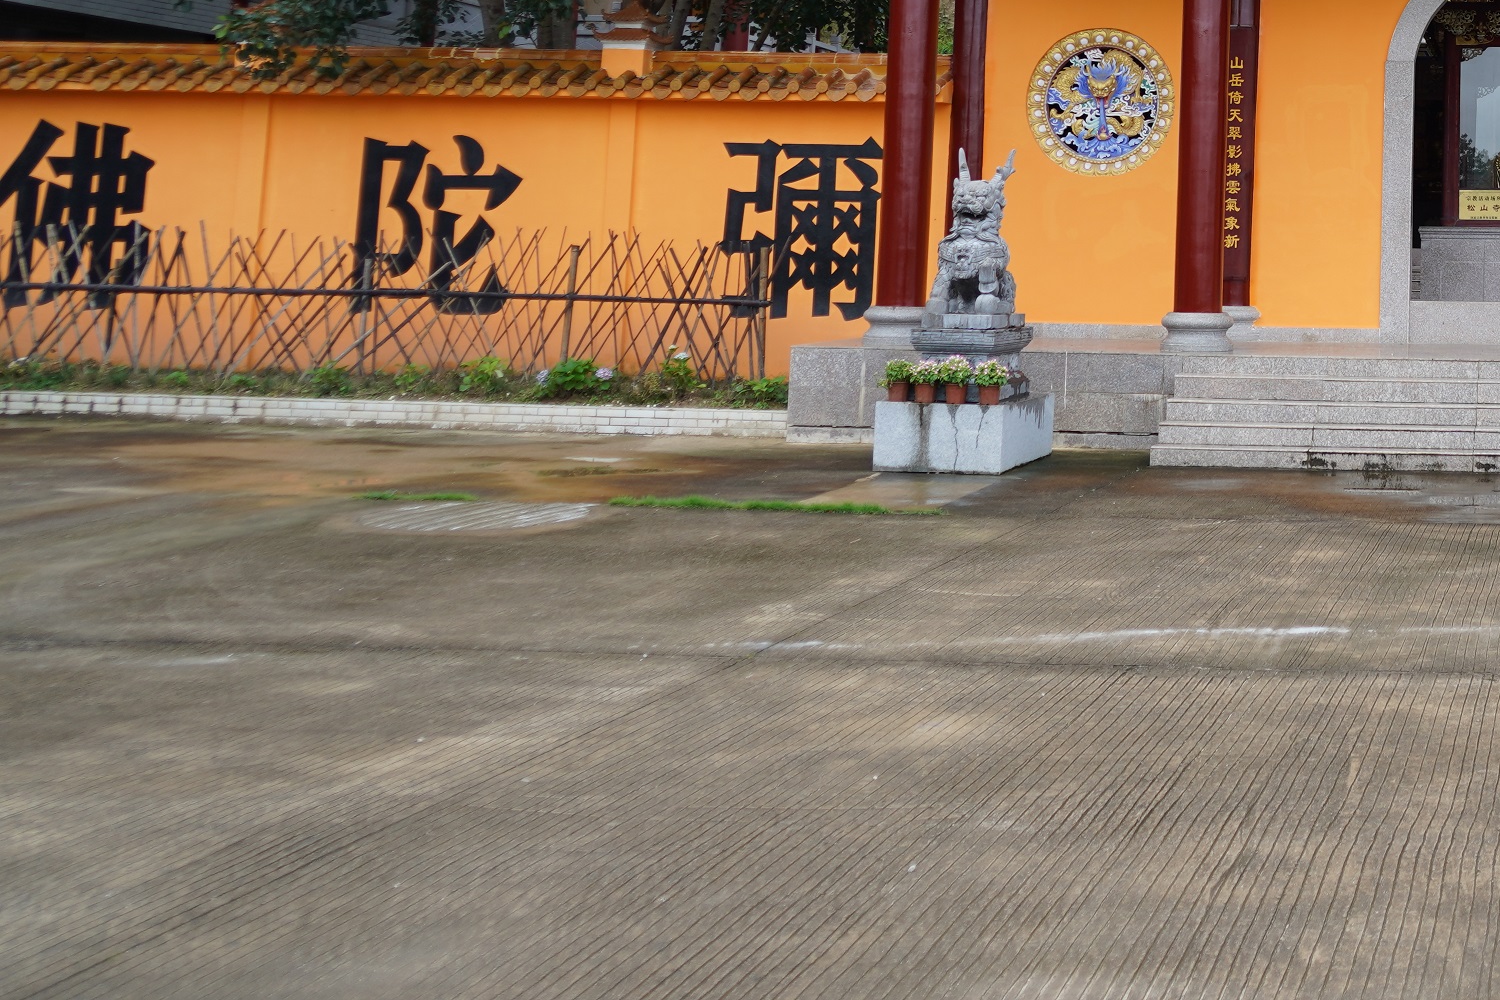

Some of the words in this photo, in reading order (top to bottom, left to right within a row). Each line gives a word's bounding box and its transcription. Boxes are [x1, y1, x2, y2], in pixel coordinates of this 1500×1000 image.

[0, 119, 156, 353] 佛
[352, 135, 523, 315] 陀
[1466, 204, 1500, 213] 松山寺
